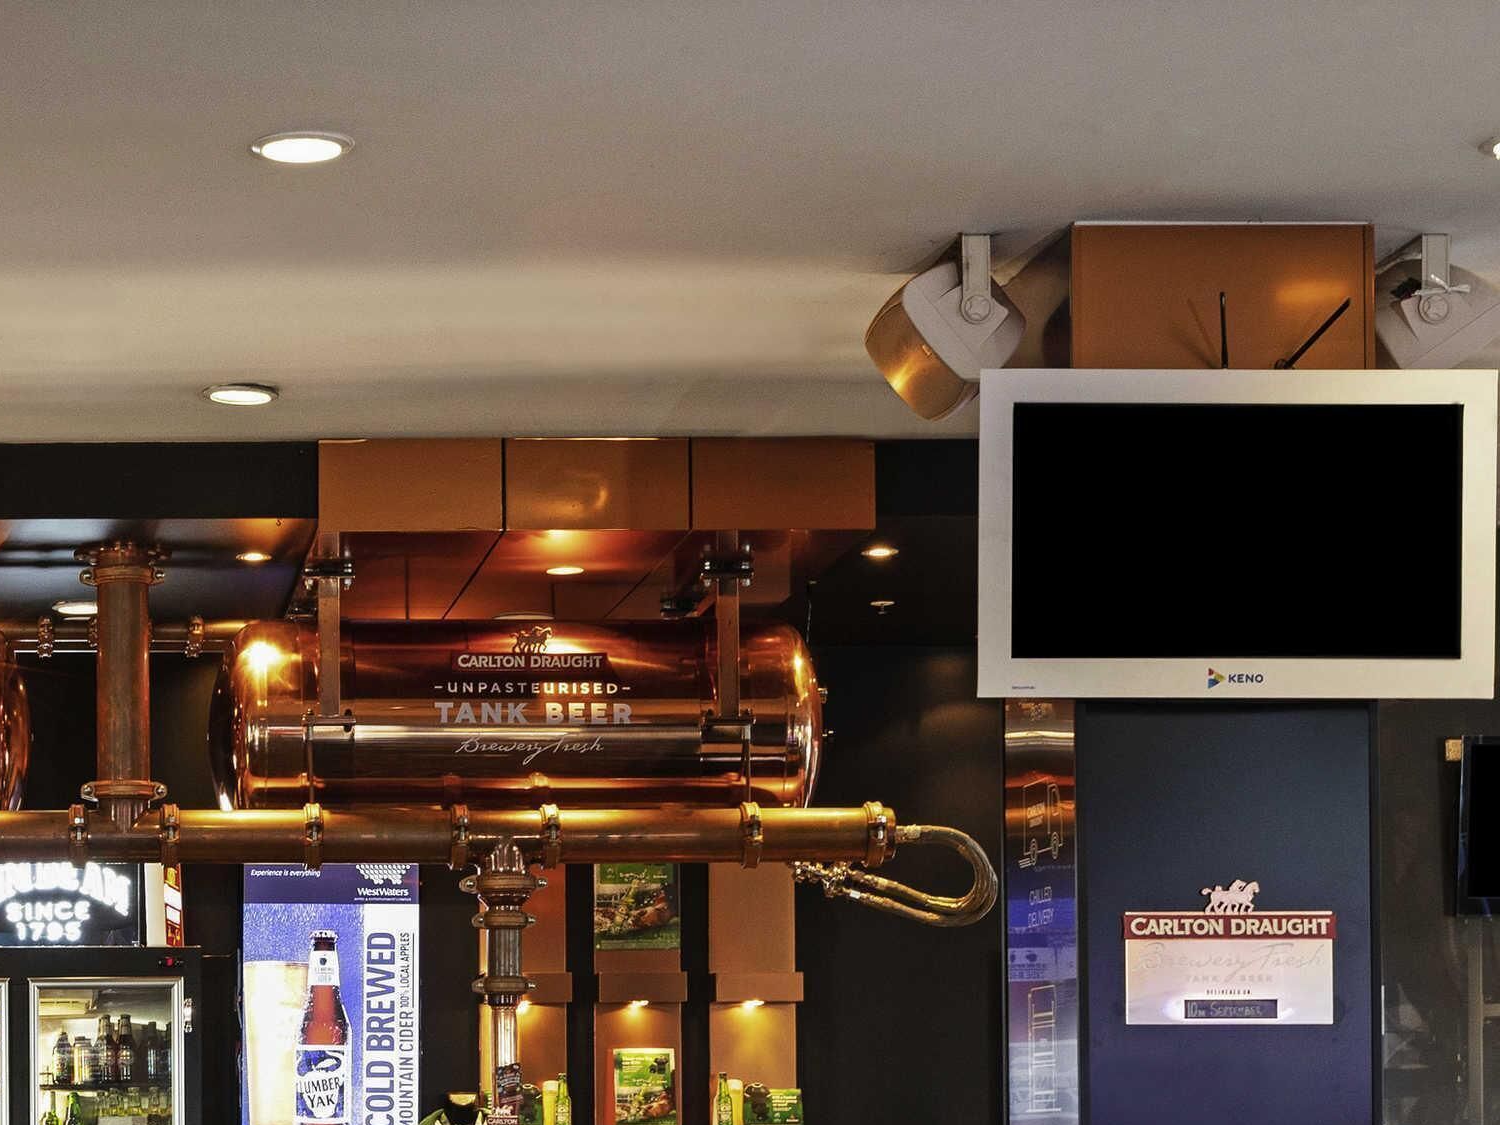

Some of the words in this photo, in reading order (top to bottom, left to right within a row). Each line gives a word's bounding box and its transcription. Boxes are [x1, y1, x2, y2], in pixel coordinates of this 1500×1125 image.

[457, 654, 525, 668] CARLTON
[529, 654, 603, 668] DRAUGHT
[1227, 674, 1264, 684] KENO
[434, 701, 529, 725] TANK
[545, 702, 633, 725] BEER
[455, 733, 550, 765] Brewery
[542, 735, 604, 754] Fresh
[250, 868, 283, 877] Experience
[289, 868, 321, 878] everything
[357, 887, 409, 897] WestWaters
[1029, 886, 1052, 906] CHILLED
[5, 900, 91, 923] SINCE
[1028, 908, 1054, 928] DELIVERY
[1129, 917, 1224, 936] CARLTON
[1230, 918, 1330, 936] DRAUGHT
[400, 932, 410, 962] APPLES
[400, 963, 410, 988] LOCAL
[366, 932, 396, 1053] BREWED
[400, 990, 410, 1008] 100%
[399, 1010, 414, 1052] CIDER
[299, 1075, 341, 1095] LUMBER
[306, 1093, 337, 1110] YAK
